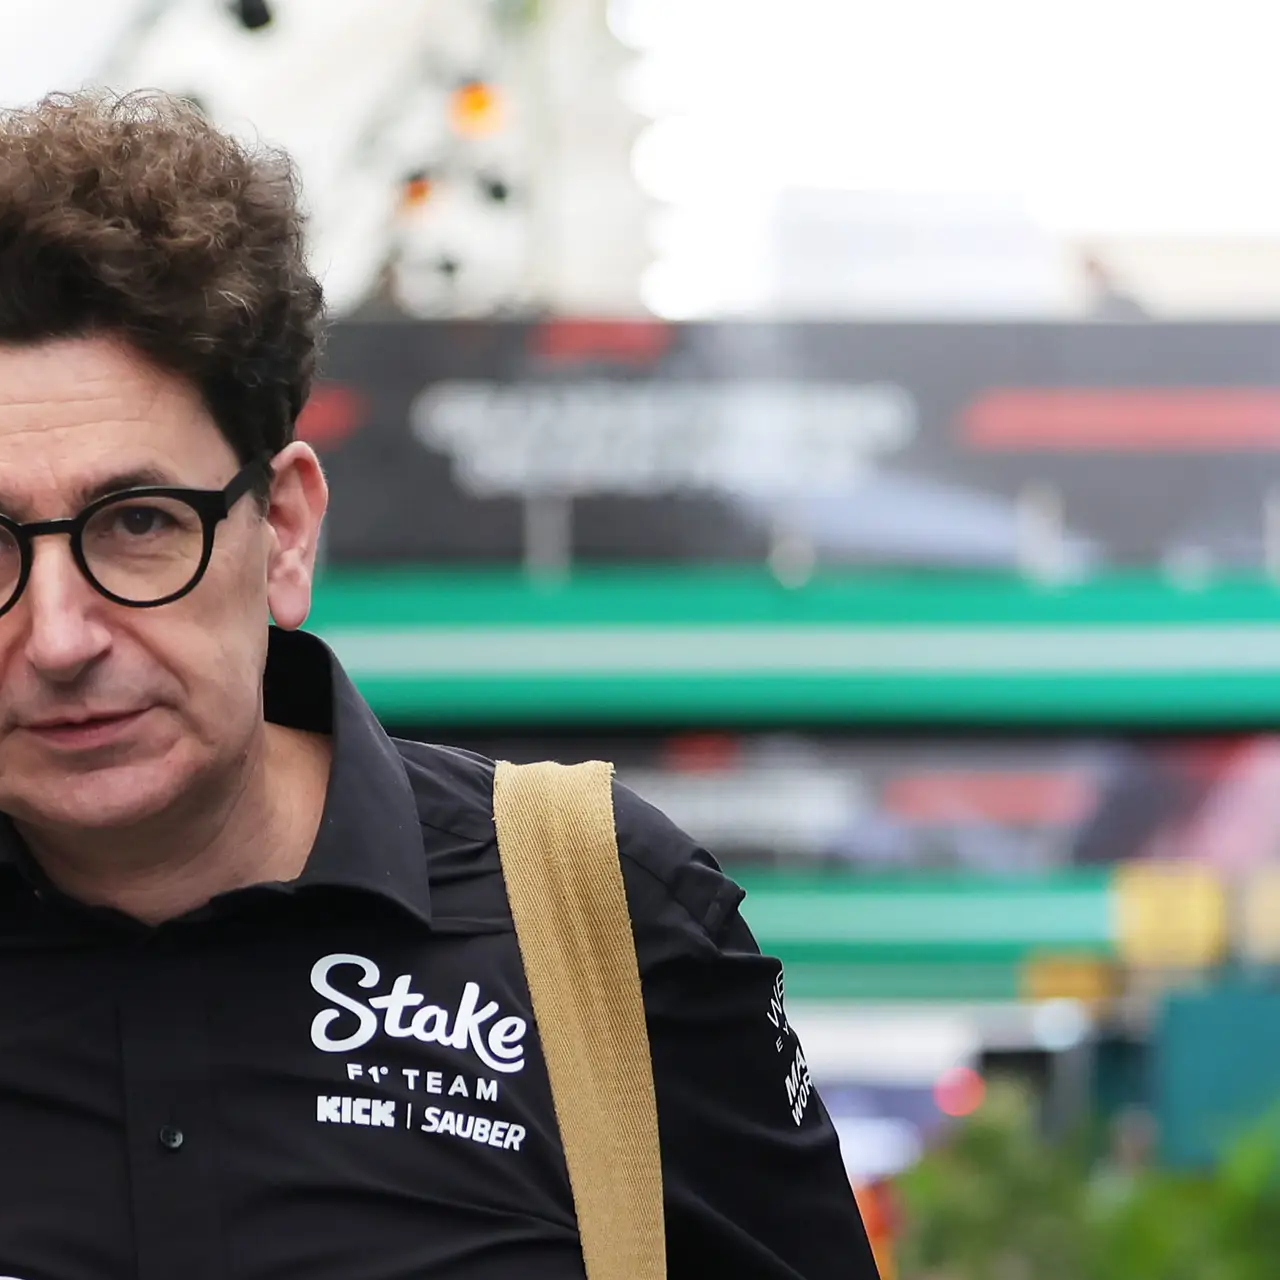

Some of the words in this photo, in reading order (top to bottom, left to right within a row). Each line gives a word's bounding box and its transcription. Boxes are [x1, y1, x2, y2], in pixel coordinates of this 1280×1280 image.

[310, 953, 526, 1073] Stake
[402, 1069, 498, 1102] TEAM
[317, 1095, 395, 1127] KICK
[421, 1106, 526, 1151] SAUBER
